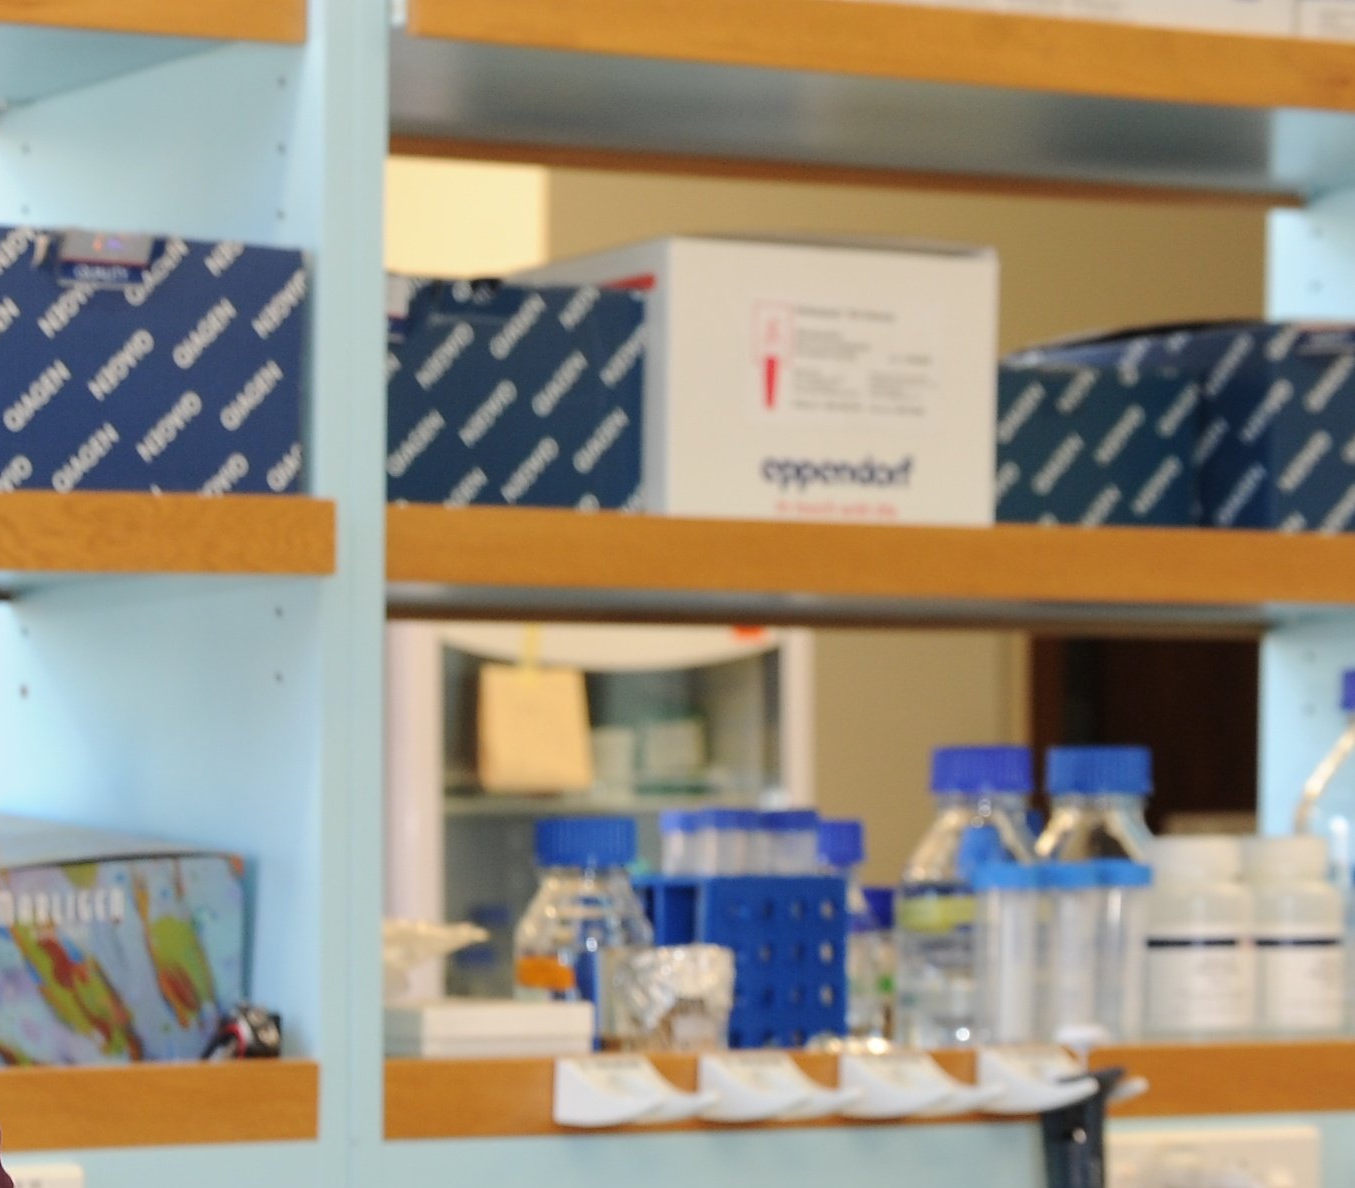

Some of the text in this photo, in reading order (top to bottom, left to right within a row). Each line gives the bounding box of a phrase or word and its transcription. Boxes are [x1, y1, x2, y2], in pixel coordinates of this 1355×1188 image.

[88, 329, 155, 401] QIAGEN
[173, 298, 237, 369] QIAGEN
[3, 360, 71, 432] QIAGEN
[137, 391, 202, 462] QIAGEN
[220, 360, 283, 431] QIAGEN
[52, 422, 120, 493] QIAGEN
[762, 455, 914, 493] eppendorf
